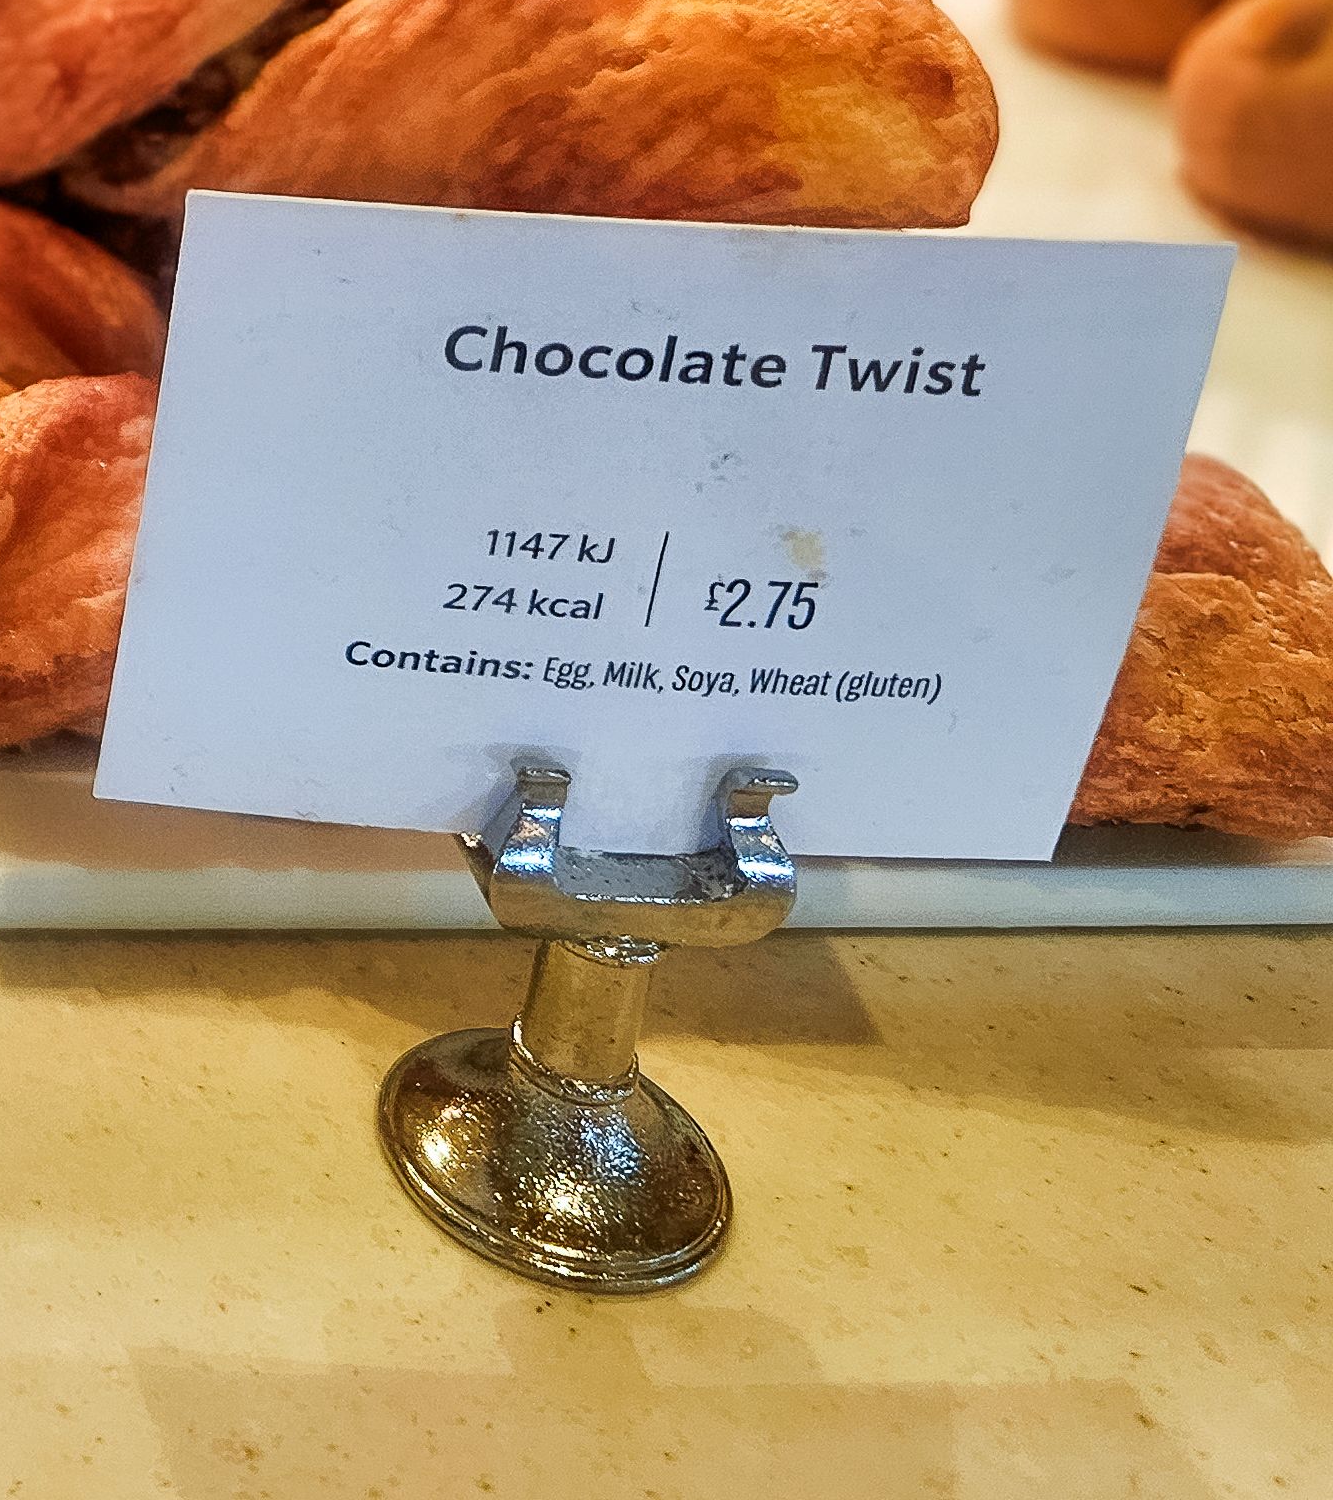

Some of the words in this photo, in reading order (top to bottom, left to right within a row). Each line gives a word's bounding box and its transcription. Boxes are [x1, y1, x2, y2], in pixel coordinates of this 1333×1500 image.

[444, 325, 787, 389] Chocolate
[811, 344, 987, 398] Twist
[486, 528, 571, 561] 1147
[576, 533, 616, 564] kJ
[442, 583, 519, 615] 274
[526, 588, 604, 620] kcal
[703, 578, 819, 631] £2.75
[344, 640, 534, 681] Contains:
[542, 656, 595, 691] Egg,
[601, 660, 664, 695] Milk,
[671, 664, 740, 698] Soya,
[749, 667, 833, 697] Wheat
[835, 670, 942, 706] (gluten)
